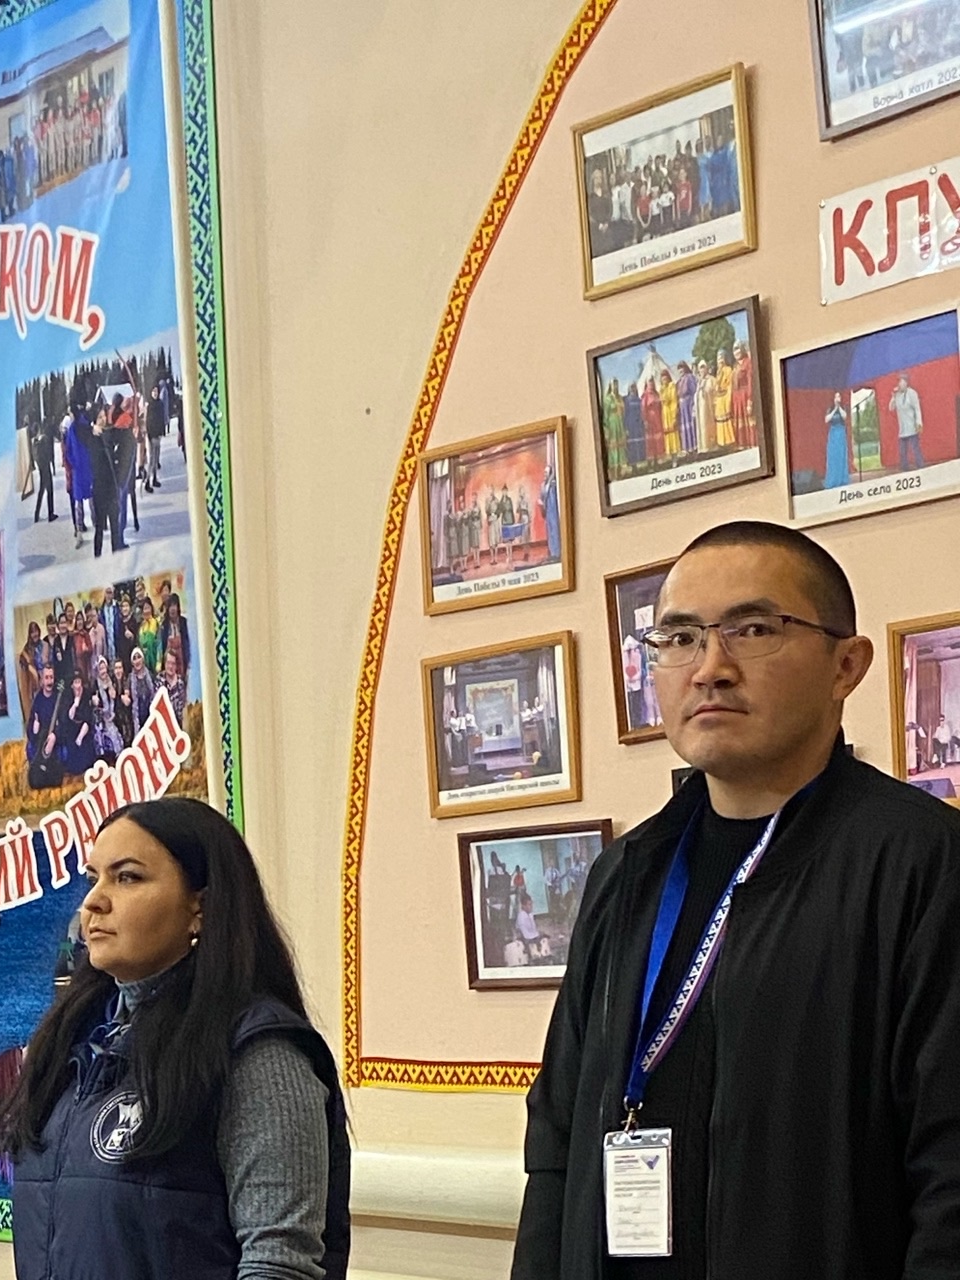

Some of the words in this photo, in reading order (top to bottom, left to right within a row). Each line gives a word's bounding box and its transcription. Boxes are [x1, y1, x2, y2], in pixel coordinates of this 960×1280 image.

[938, 67, 960, 84] 202
[620, 263, 638, 274] День
[640, 251, 671, 267] Победы
[680, 243, 695, 255] мая
[651, 477, 672, 490] День
[675, 472, 696, 483] села
[699, 463, 723, 479] 2023
[839, 489, 864, 503] День
[867, 485, 891, 496] села
[895, 476, 921, 491] 2023
[474, 581, 500, 592] Победы
[42, 688, 189, 886] РАЙОН!
